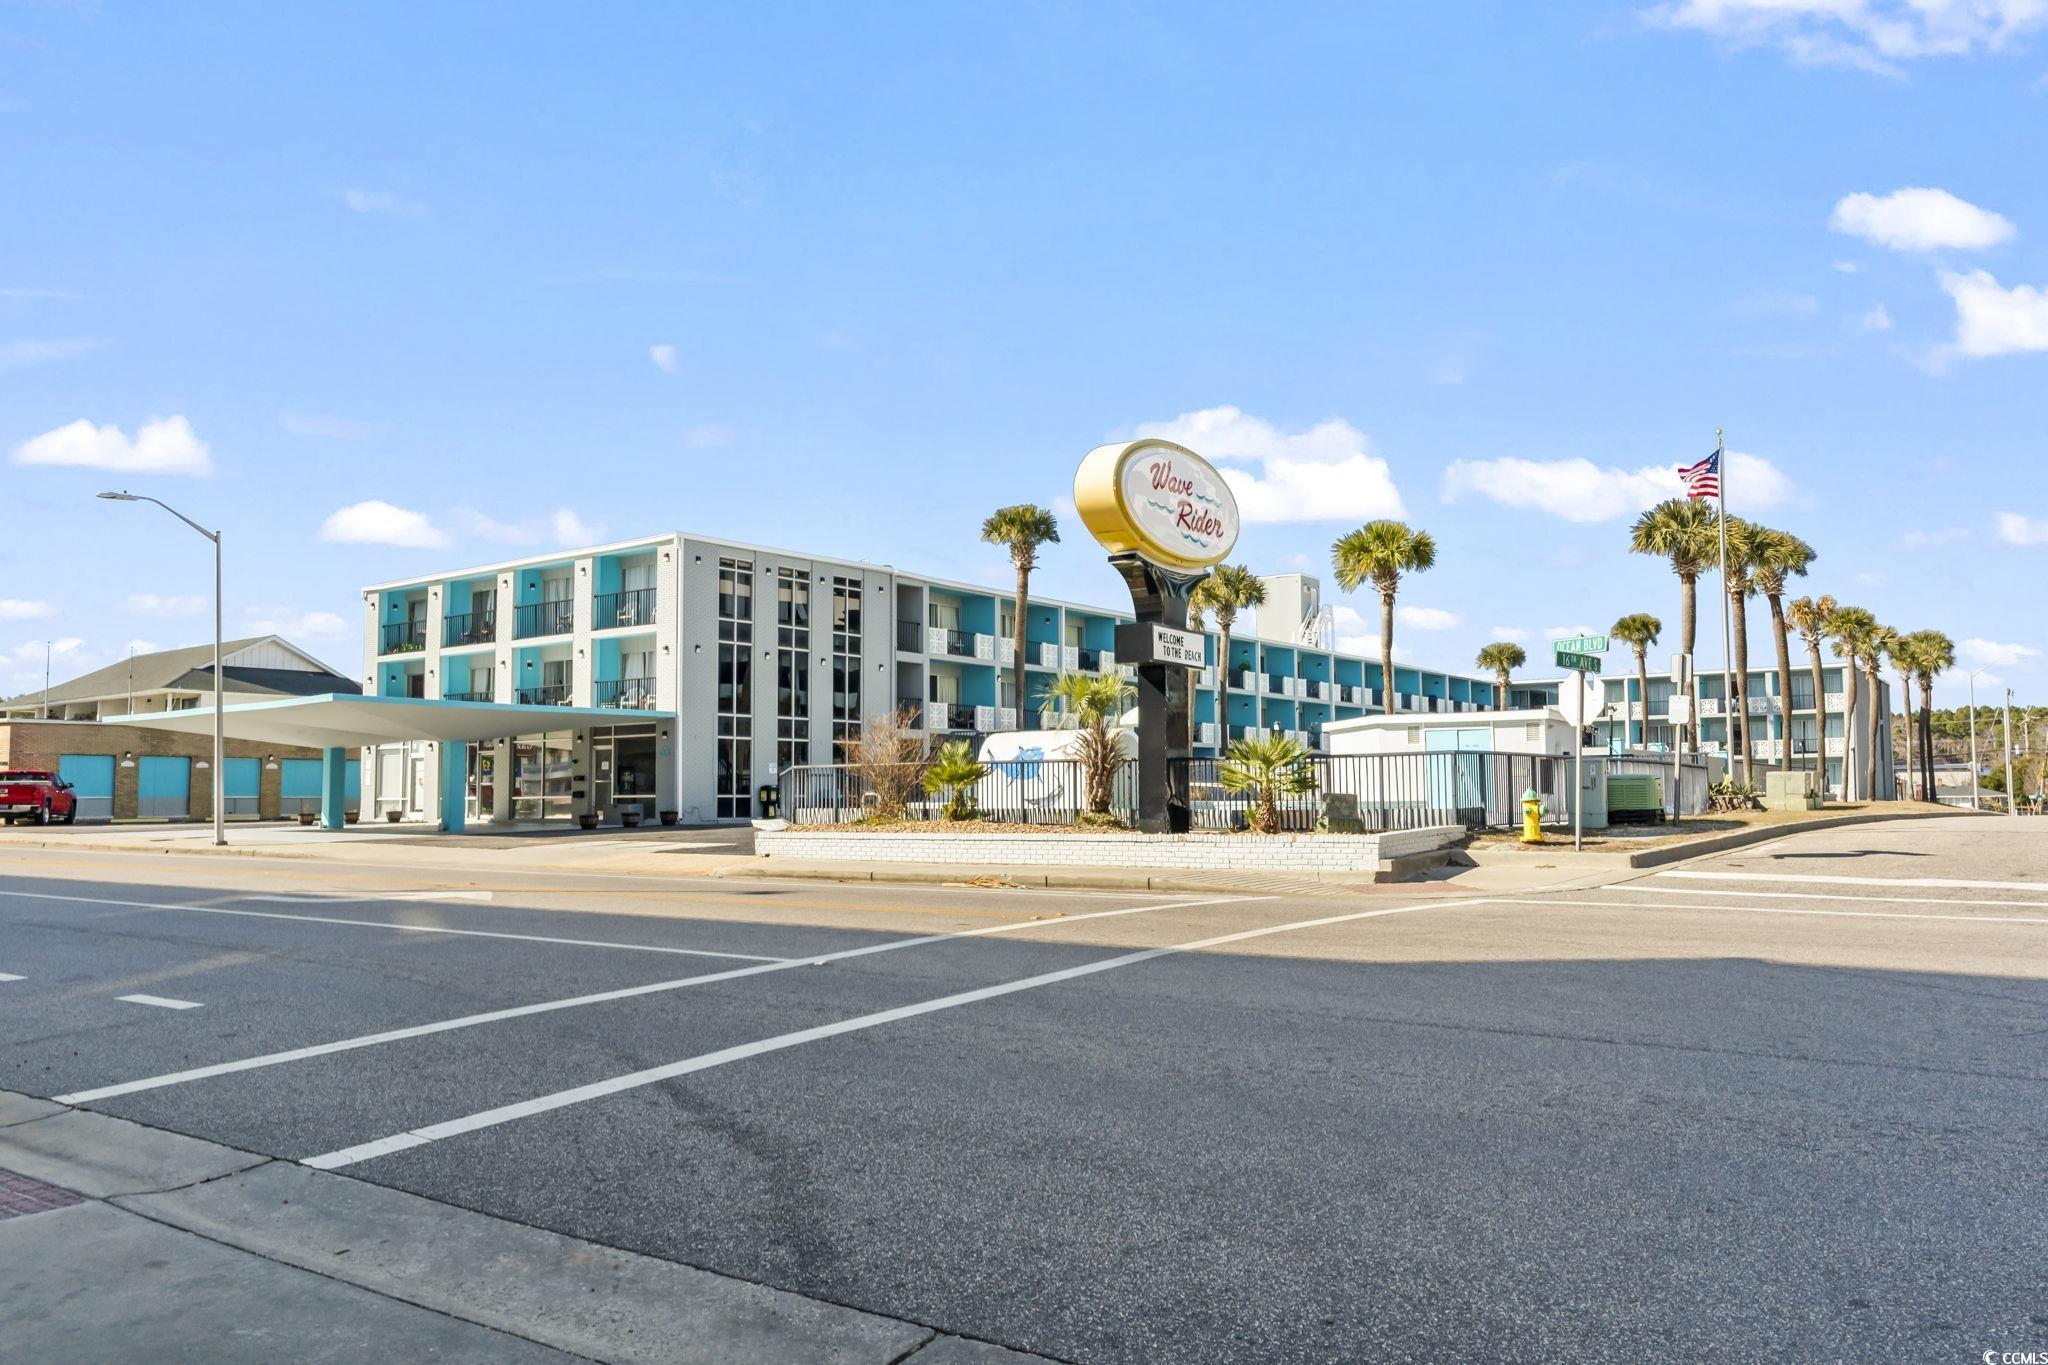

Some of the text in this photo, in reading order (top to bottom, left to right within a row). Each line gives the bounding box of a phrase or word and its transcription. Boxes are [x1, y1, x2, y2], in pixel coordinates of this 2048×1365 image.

[1150, 461, 1193, 496] Wave
[1177, 500, 1224, 538] Rider
[1158, 632, 1184, 646] WELCOME
[1557, 637, 1603, 653] OCEAN BLVD
[1163, 645, 1201, 662] TO THE BEACH
[1562, 654, 1598, 671] 16TH AVE S
